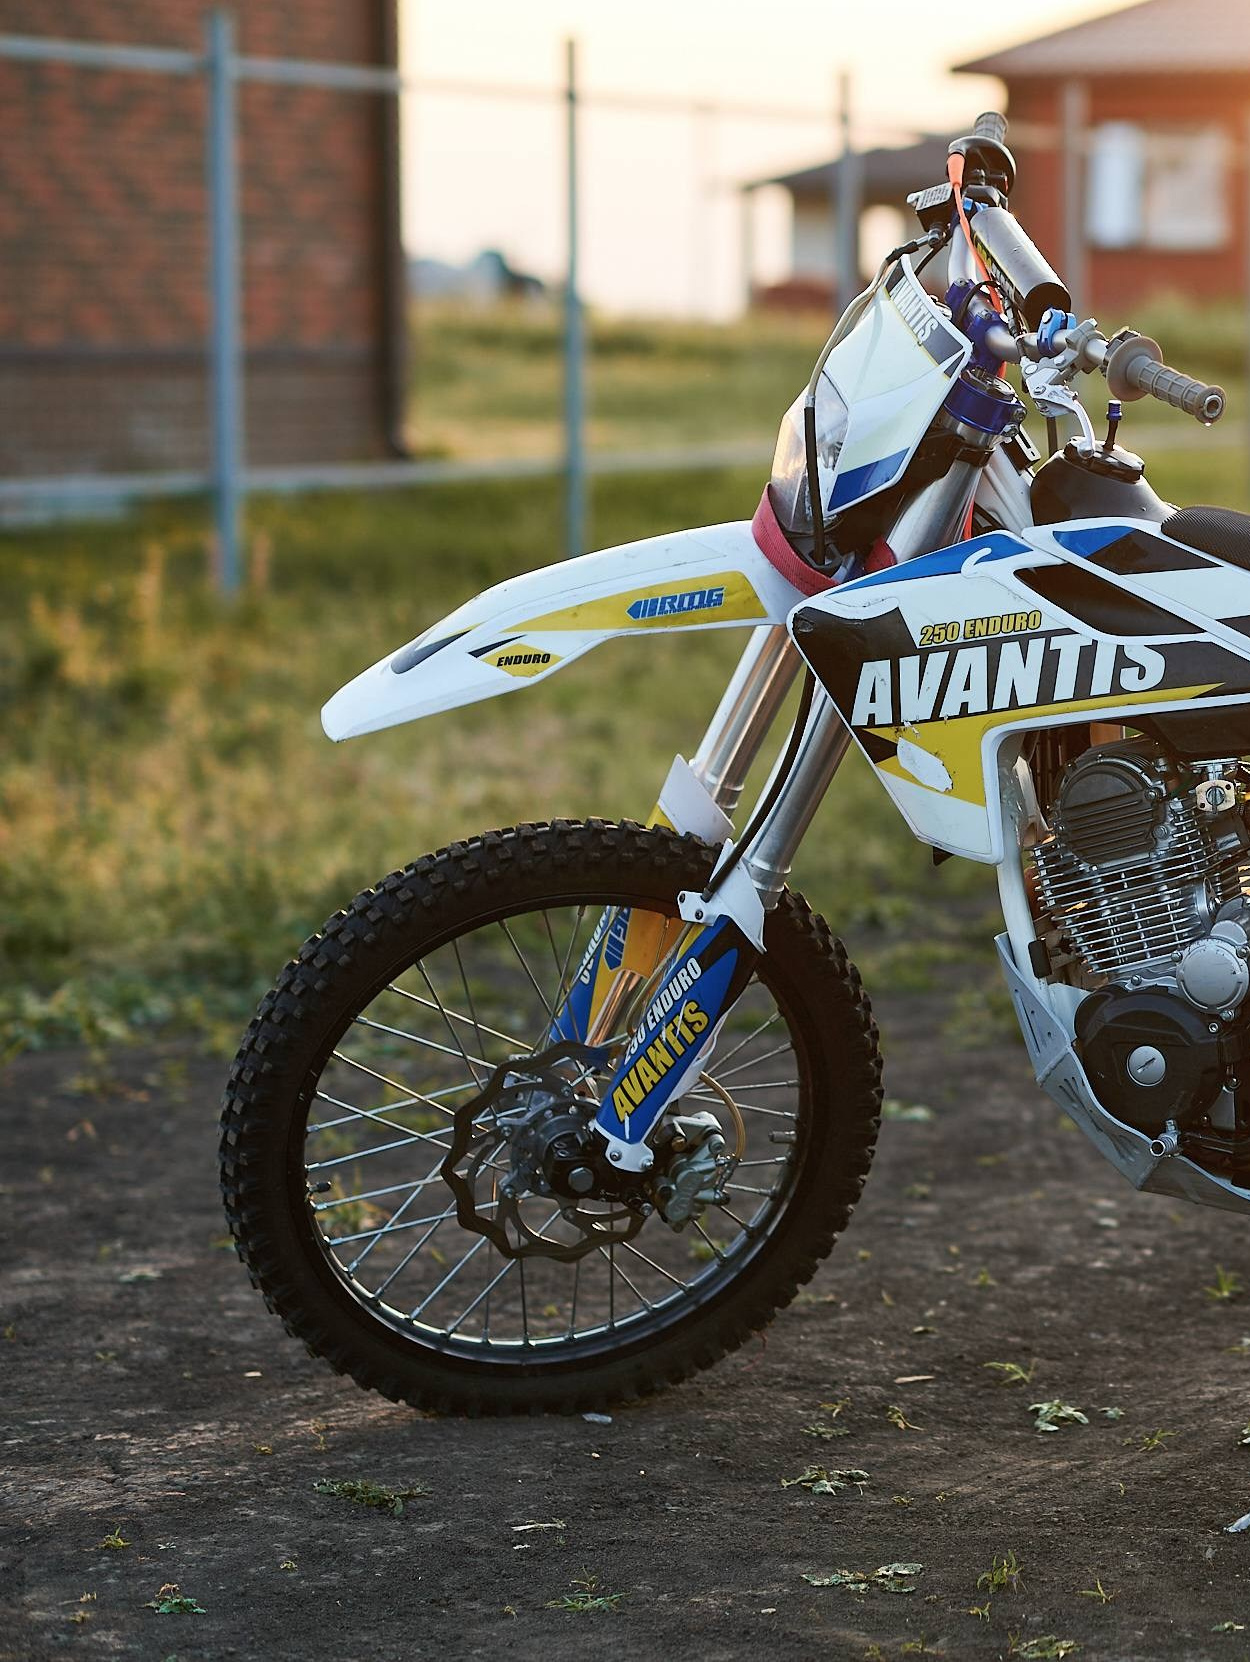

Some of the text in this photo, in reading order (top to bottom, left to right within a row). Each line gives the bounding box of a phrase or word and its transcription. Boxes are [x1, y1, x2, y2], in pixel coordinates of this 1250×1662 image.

[497, 653, 551, 667] ENDURO
[920, 610, 1042, 646] 250 ENDURO
[851, 633, 1166, 726] AVANTIS
[646, 957, 702, 1032] ENDURO
[612, 1000, 709, 1123] AVANTIS
